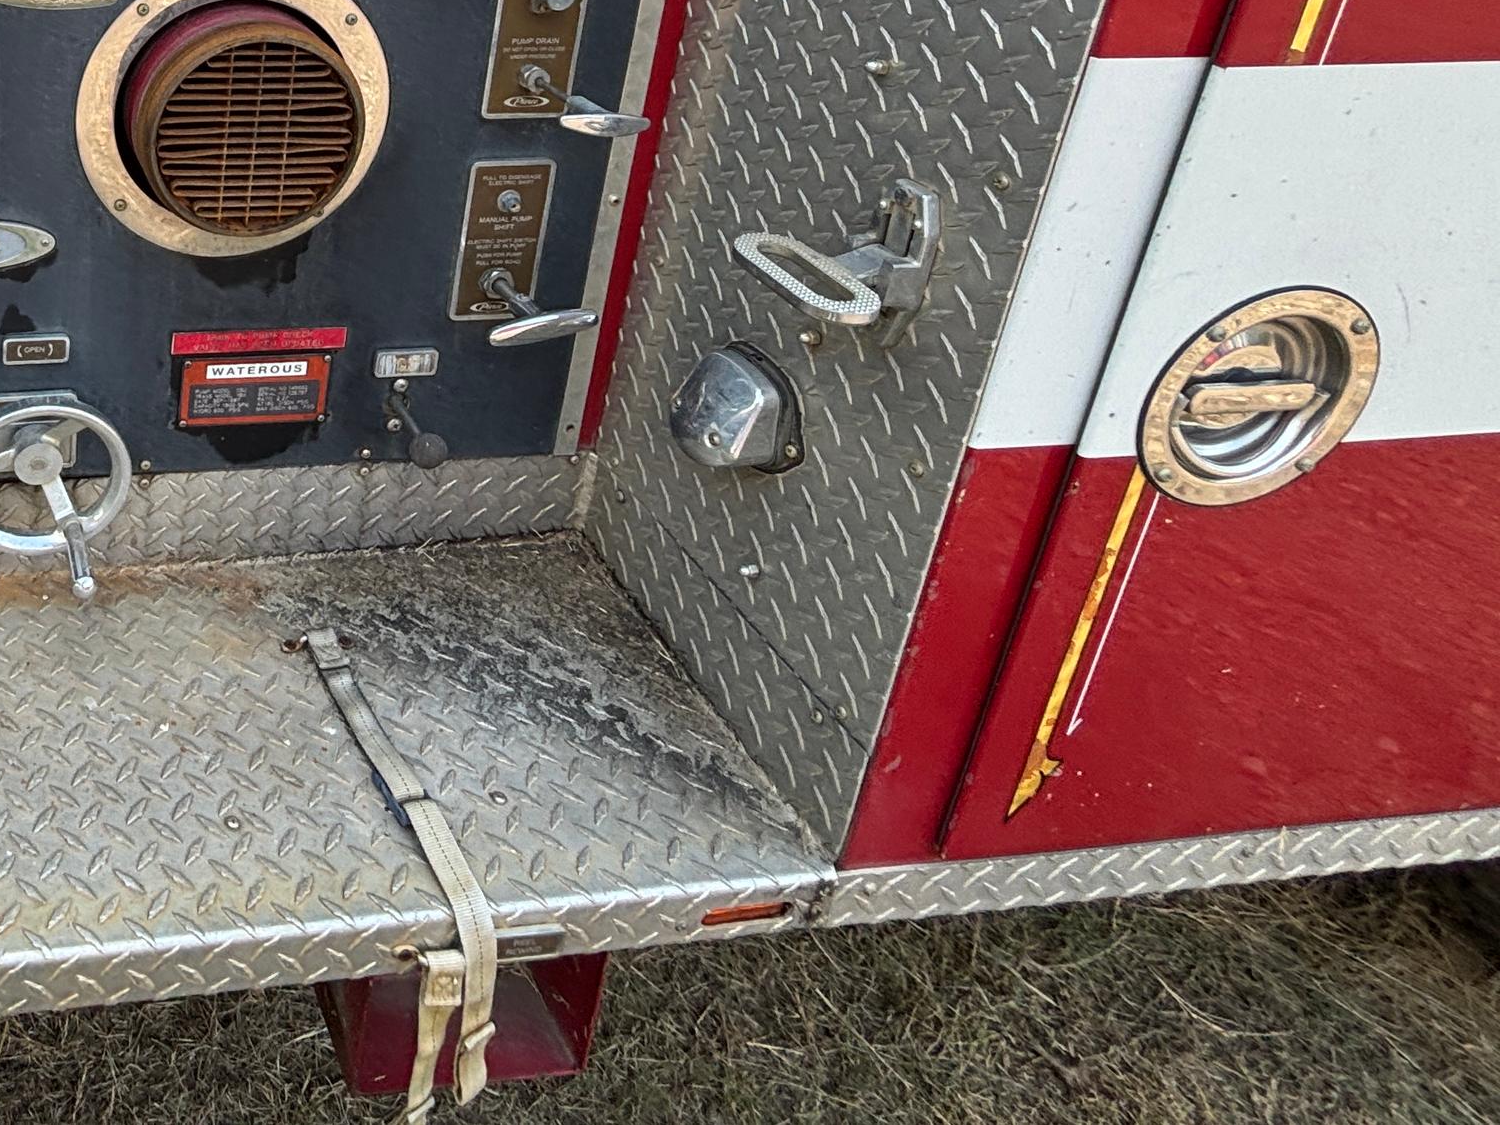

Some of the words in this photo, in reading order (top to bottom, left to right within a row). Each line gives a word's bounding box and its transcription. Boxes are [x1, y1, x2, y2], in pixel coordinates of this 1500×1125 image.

[511, 37, 534, 45] PUMP
[478, 216, 509, 224] MANUAL
[212, 364, 303, 376] WATEROUS
